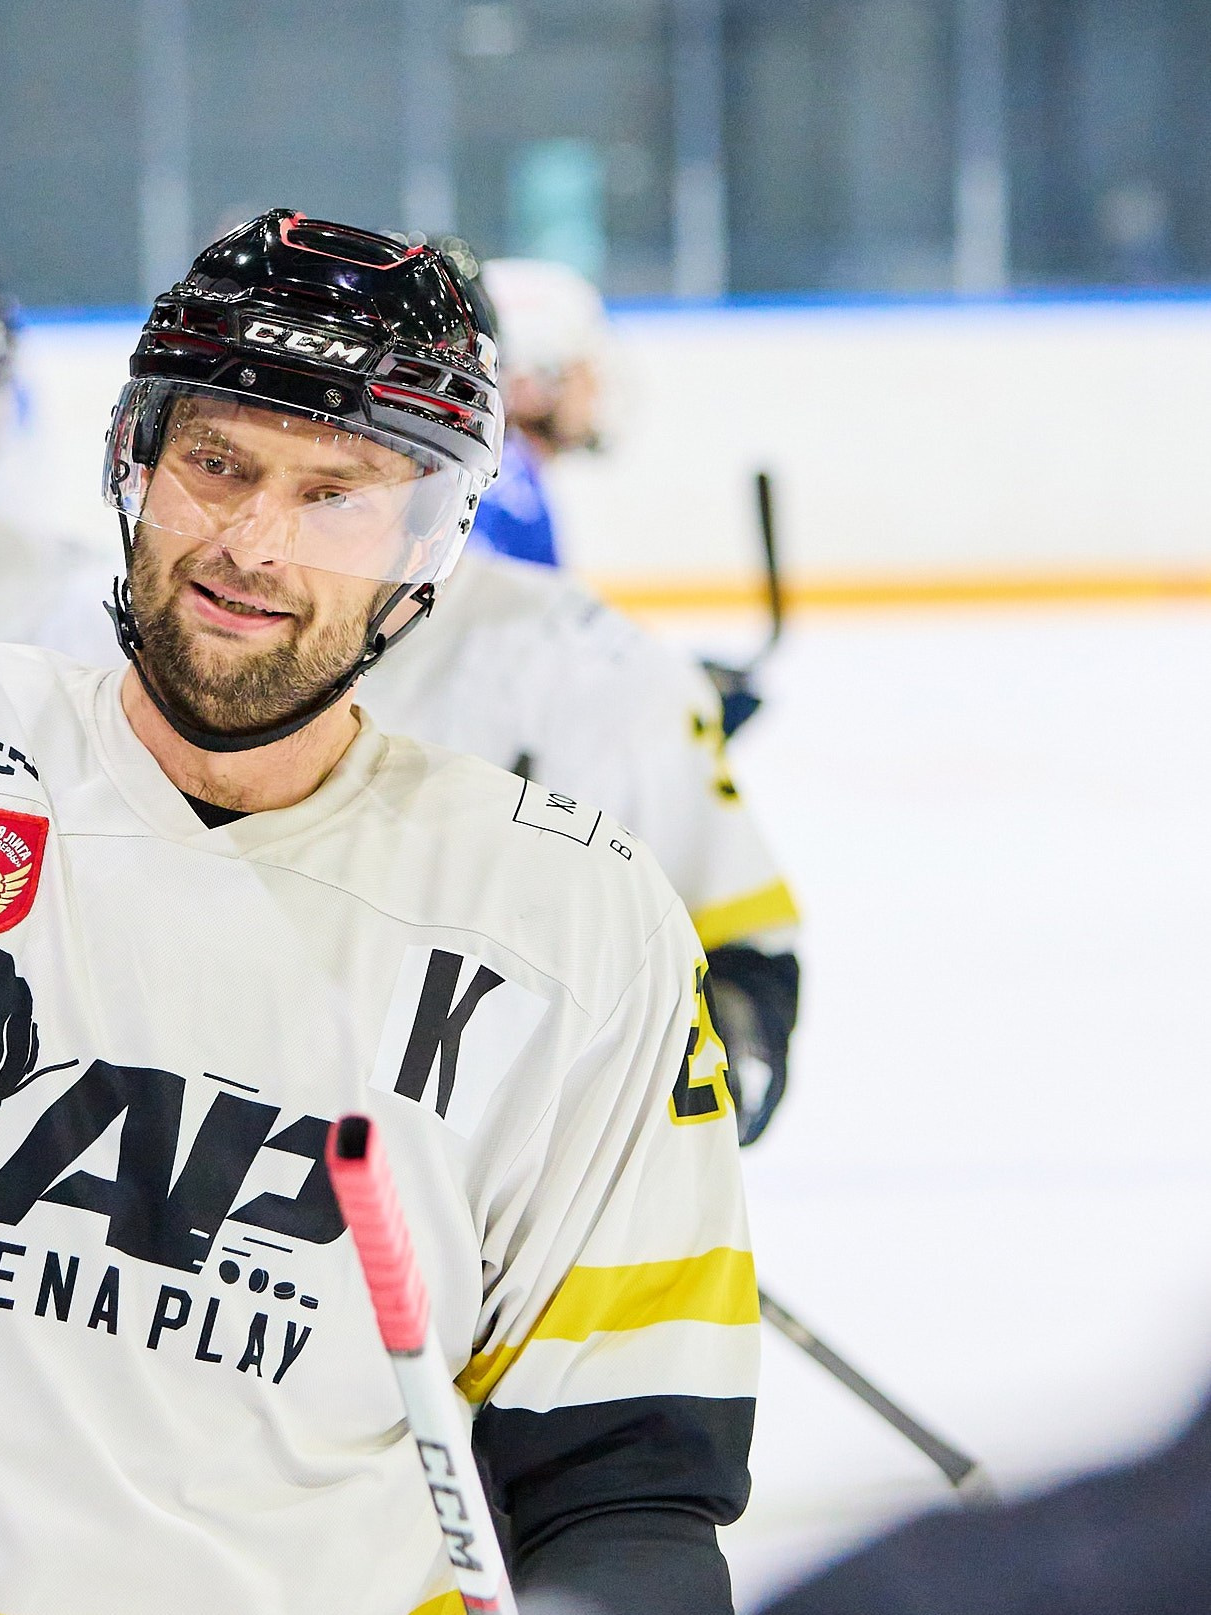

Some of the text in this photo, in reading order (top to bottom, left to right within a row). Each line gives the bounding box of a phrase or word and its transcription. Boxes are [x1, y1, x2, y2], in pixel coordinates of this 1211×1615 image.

[244, 321, 368, 364] CCM
[3, 831, 32, 861] ЛИГА
[146, 1283, 313, 1385] PLAY
[416, 1438, 484, 1572] CCM
